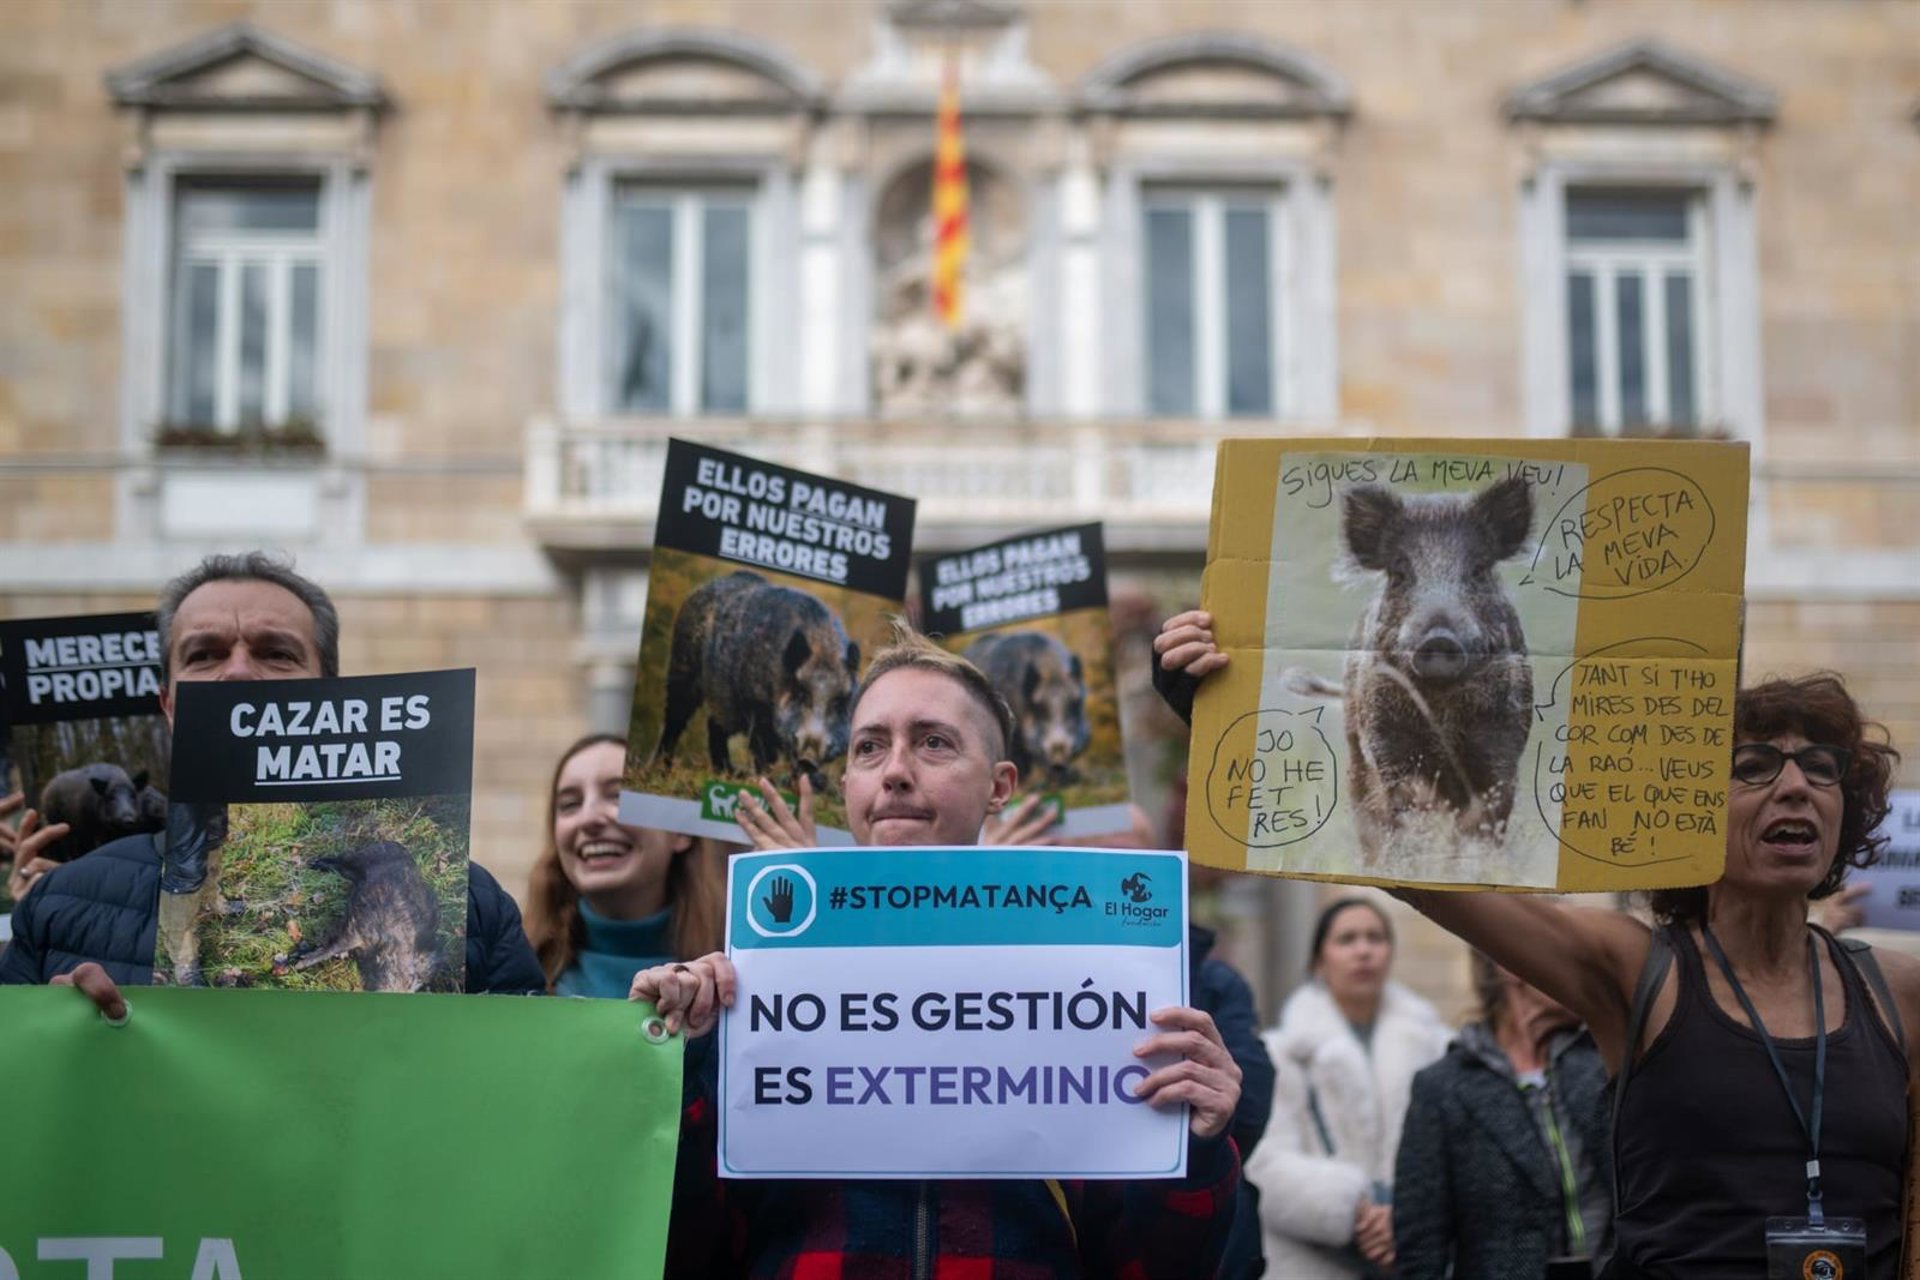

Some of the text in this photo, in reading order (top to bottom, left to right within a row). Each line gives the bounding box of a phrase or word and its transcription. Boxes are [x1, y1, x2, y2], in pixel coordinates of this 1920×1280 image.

[1389, 461, 1418, 483] LA
[1432, 460, 1495, 484] MEVA
[697, 458, 886, 528] ELLOS PAGAN
[683, 486, 891, 560] POR NUESTROS
[1560, 489, 1694, 550] RESPECTA
[720, 526, 848, 581] ERRORES
[1556, 523, 1679, 580] LA MEVA
[27, 666, 160, 704] PROPIA
[1579, 664, 1630, 687] TANT
[1671, 669, 1716, 690] T'HO
[230, 695, 431, 738] CAZAR ES
[1644, 696, 1682, 715] DES
[1692, 697, 1729, 718] DEL
[1257, 729, 1294, 753] JO
[1555, 724, 1726, 747] COR COM DES DE
[256, 741, 401, 781] MATAR
[1228, 758, 1324, 783] NO HE
[1549, 755, 1574, 773] LA
[1660, 757, 1714, 781] VEUS
[1227, 786, 1294, 809] FET
[1550, 782, 1726, 809] QUE EL QUE ENS
[1562, 808, 1607, 829] FAN
[1634, 809, 1670, 829] NO
[829, 884, 1093, 914] #STOPMATANÇA
[1105, 902, 1169, 921] El Hogar
[750, 977, 1147, 1032] NO ES GESTIÓN
[754, 1064, 1153, 1106] ES EXTERMINIO
